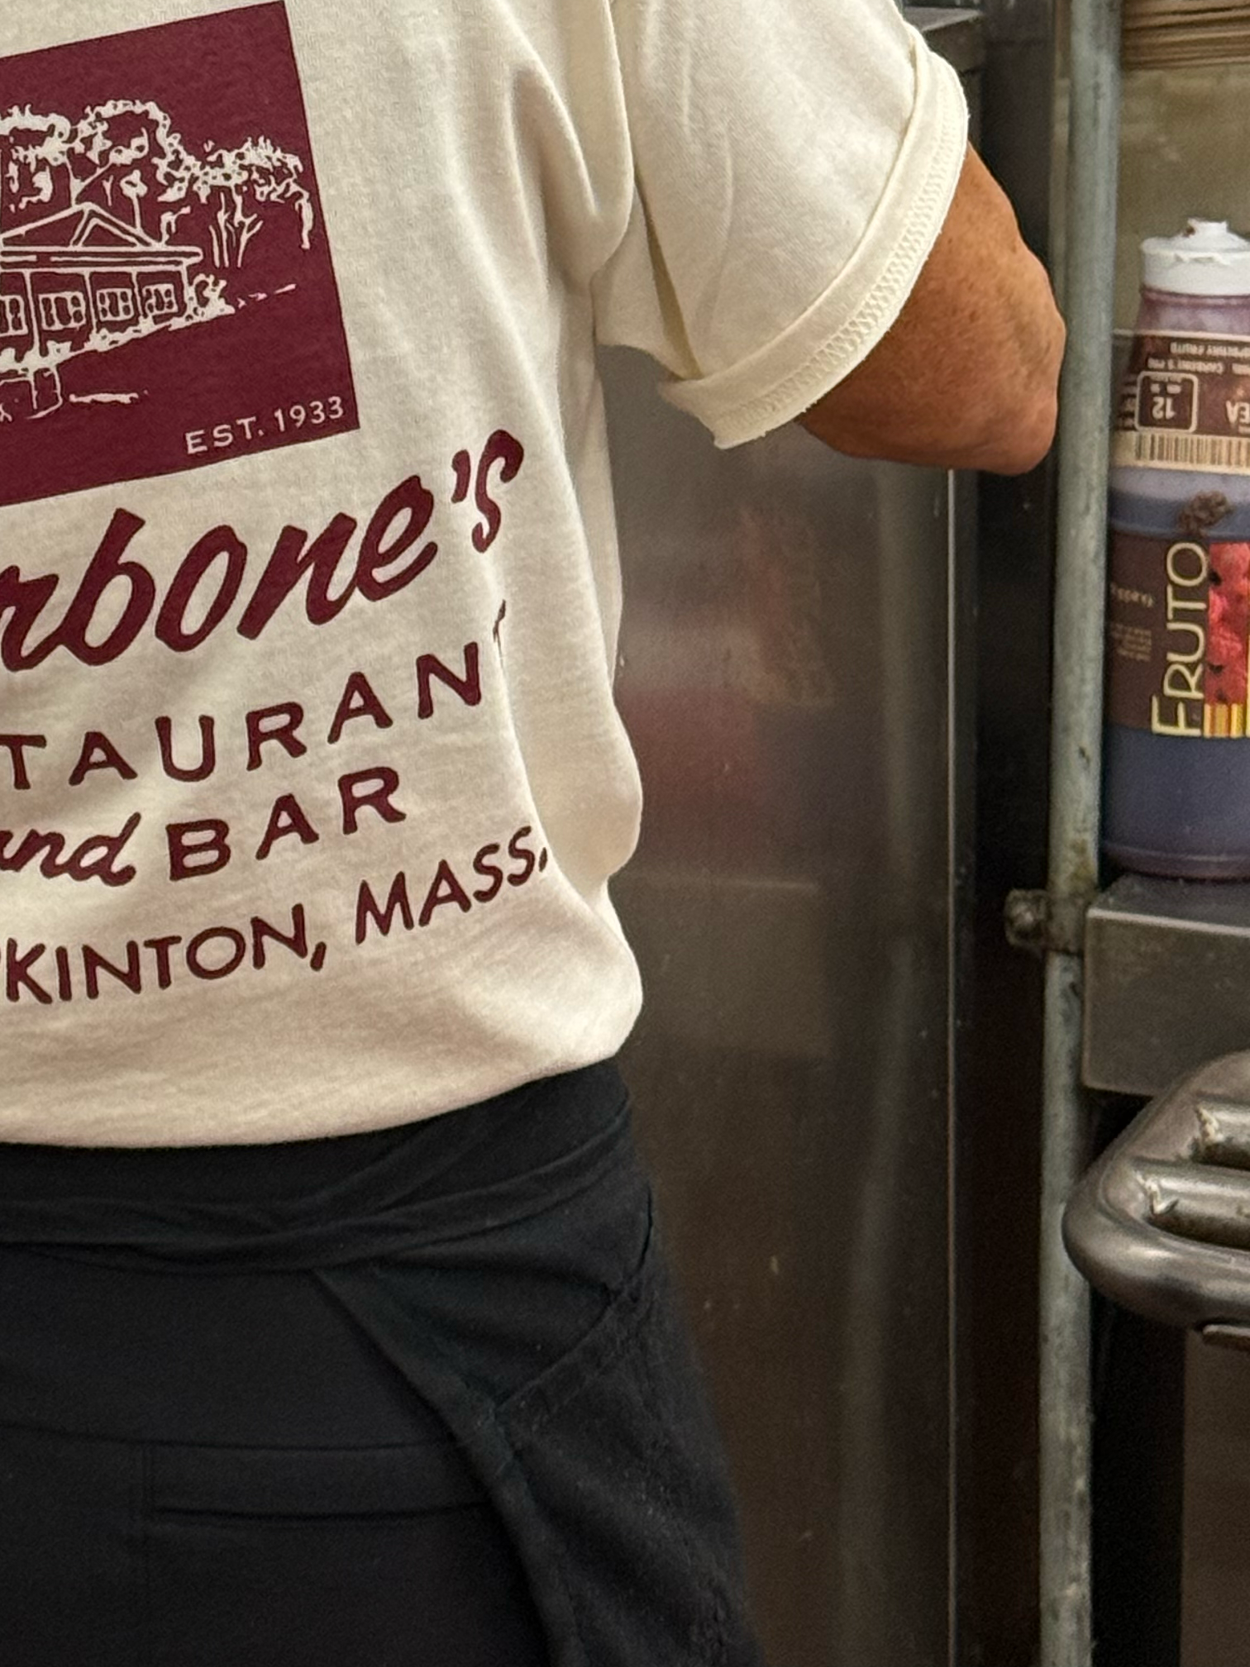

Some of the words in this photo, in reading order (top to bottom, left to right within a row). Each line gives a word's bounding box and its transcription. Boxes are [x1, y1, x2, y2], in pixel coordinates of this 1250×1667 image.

[185, 416, 265, 454] EST.
[274, 396, 344, 432] 1933
[1151, 542, 1209, 736] FRUTO
[165, 764, 406, 882] BAR
